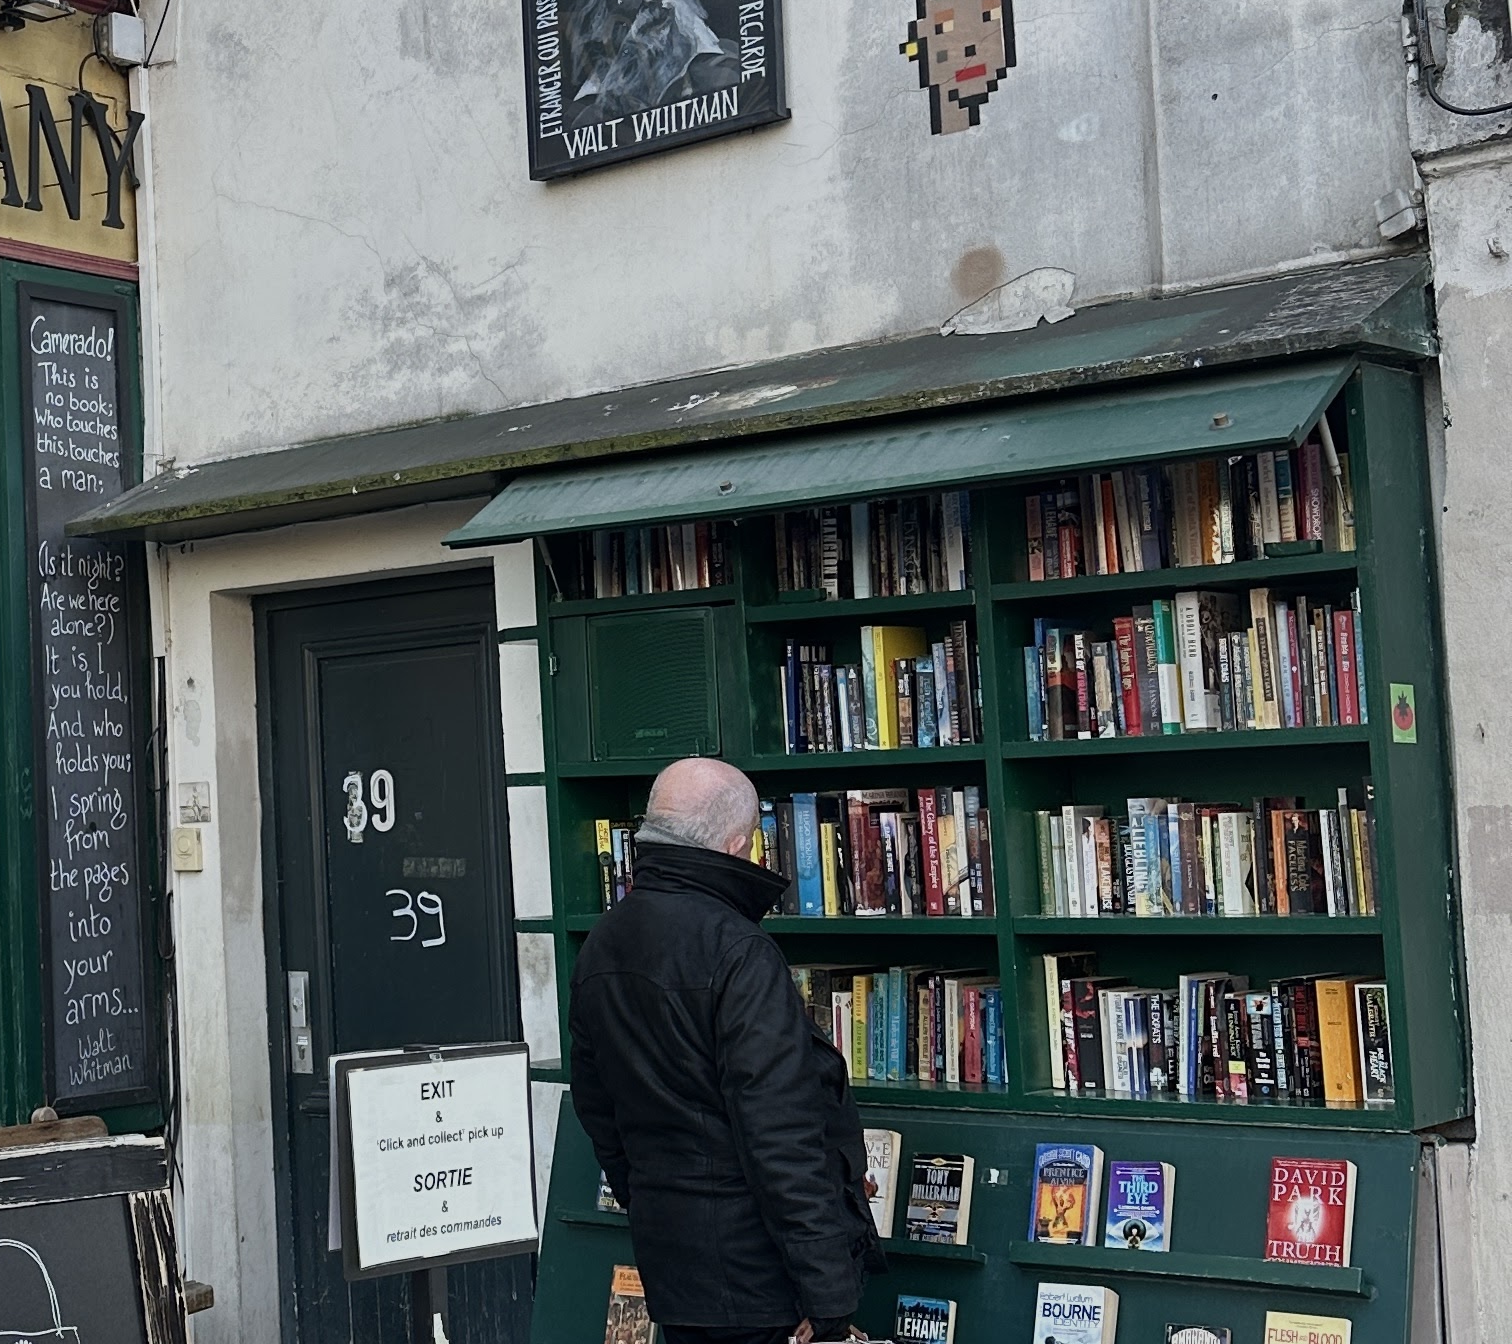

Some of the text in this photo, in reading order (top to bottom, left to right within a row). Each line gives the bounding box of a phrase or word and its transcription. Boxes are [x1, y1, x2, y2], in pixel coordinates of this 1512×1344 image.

[537, 30, 561, 61] QUI
[739, 0, 766, 83] REGARDE
[539, 60, 563, 138] ETRANGER
[562, 86, 739, 159] WALT WHITMAN
[30, 315, 115, 362] Camerado!
[38, 362, 99, 390] This is
[45, 392, 114, 416] no book;
[34, 407, 118, 440] Who touches
[37, 436, 120, 468] this, touches
[39, 468, 104, 494] a man;
[38, 539, 124, 590] (Is it night?
[40, 582, 120, 614] Are we here
[51, 612, 115, 645] alone?)
[1119, 634, 1130, 646] The
[45, 642, 104, 674] It is I
[49, 672, 128, 710] you hold,
[46, 710, 123, 740] And who
[55, 742, 100, 776] holds
[52, 786, 58, 820] I
[69, 787, 127, 830] spring
[342, 769, 396, 834] 39
[64, 821, 111, 855] from
[802, 810, 813, 869] HUGO YOUNG
[925, 796, 941, 889] The Glory of the Empire
[1131, 827, 1148, 890] LIEBLING
[1287, 840, 1298, 892] FACELESS
[1296, 840, 1310, 892] Martina Cole
[50, 858, 129, 902] the pages
[69, 910, 112, 942] into
[385, 888, 446, 948] 39
[63, 950, 113, 994] your
[65, 987, 139, 1025] arms...
[1150, 994, 1162, 1044] THE EXPATS
[78, 1028, 116, 1059] Walt
[69, 1054, 133, 1086] Whitman
[1369, 1050, 1380, 1080] HEART
[421, 1079, 456, 1101] EXIT
[435, 1110, 443, 1123] &
[407, 1134, 426, 1148] and
[468, 1126, 489, 1143] pick
[491, 1126, 504, 1141] up
[413, 1167, 473, 1193] SORTIE
[926, 1168, 950, 1185] TONY
[1043, 1168, 1085, 1178] PRENTICE
[1118, 1181, 1159, 1194] THIRD
[1273, 1166, 1346, 1186] DAVID
[441, 1200, 449, 1213] &
[911, 1183, 961, 1203] HILLERMAN
[1126, 1193, 1150, 1205] EYE
[1272, 1183, 1344, 1206] PARK
[386, 1215, 503, 1244] retrait des commandes
[1268, 1239, 1342, 1262] TRUTH
[1041, 1302, 1102, 1322] BOURNE
[1053, 1317, 1100, 1328] IDENTITY
[896, 1316, 947, 1341] LEHANE
